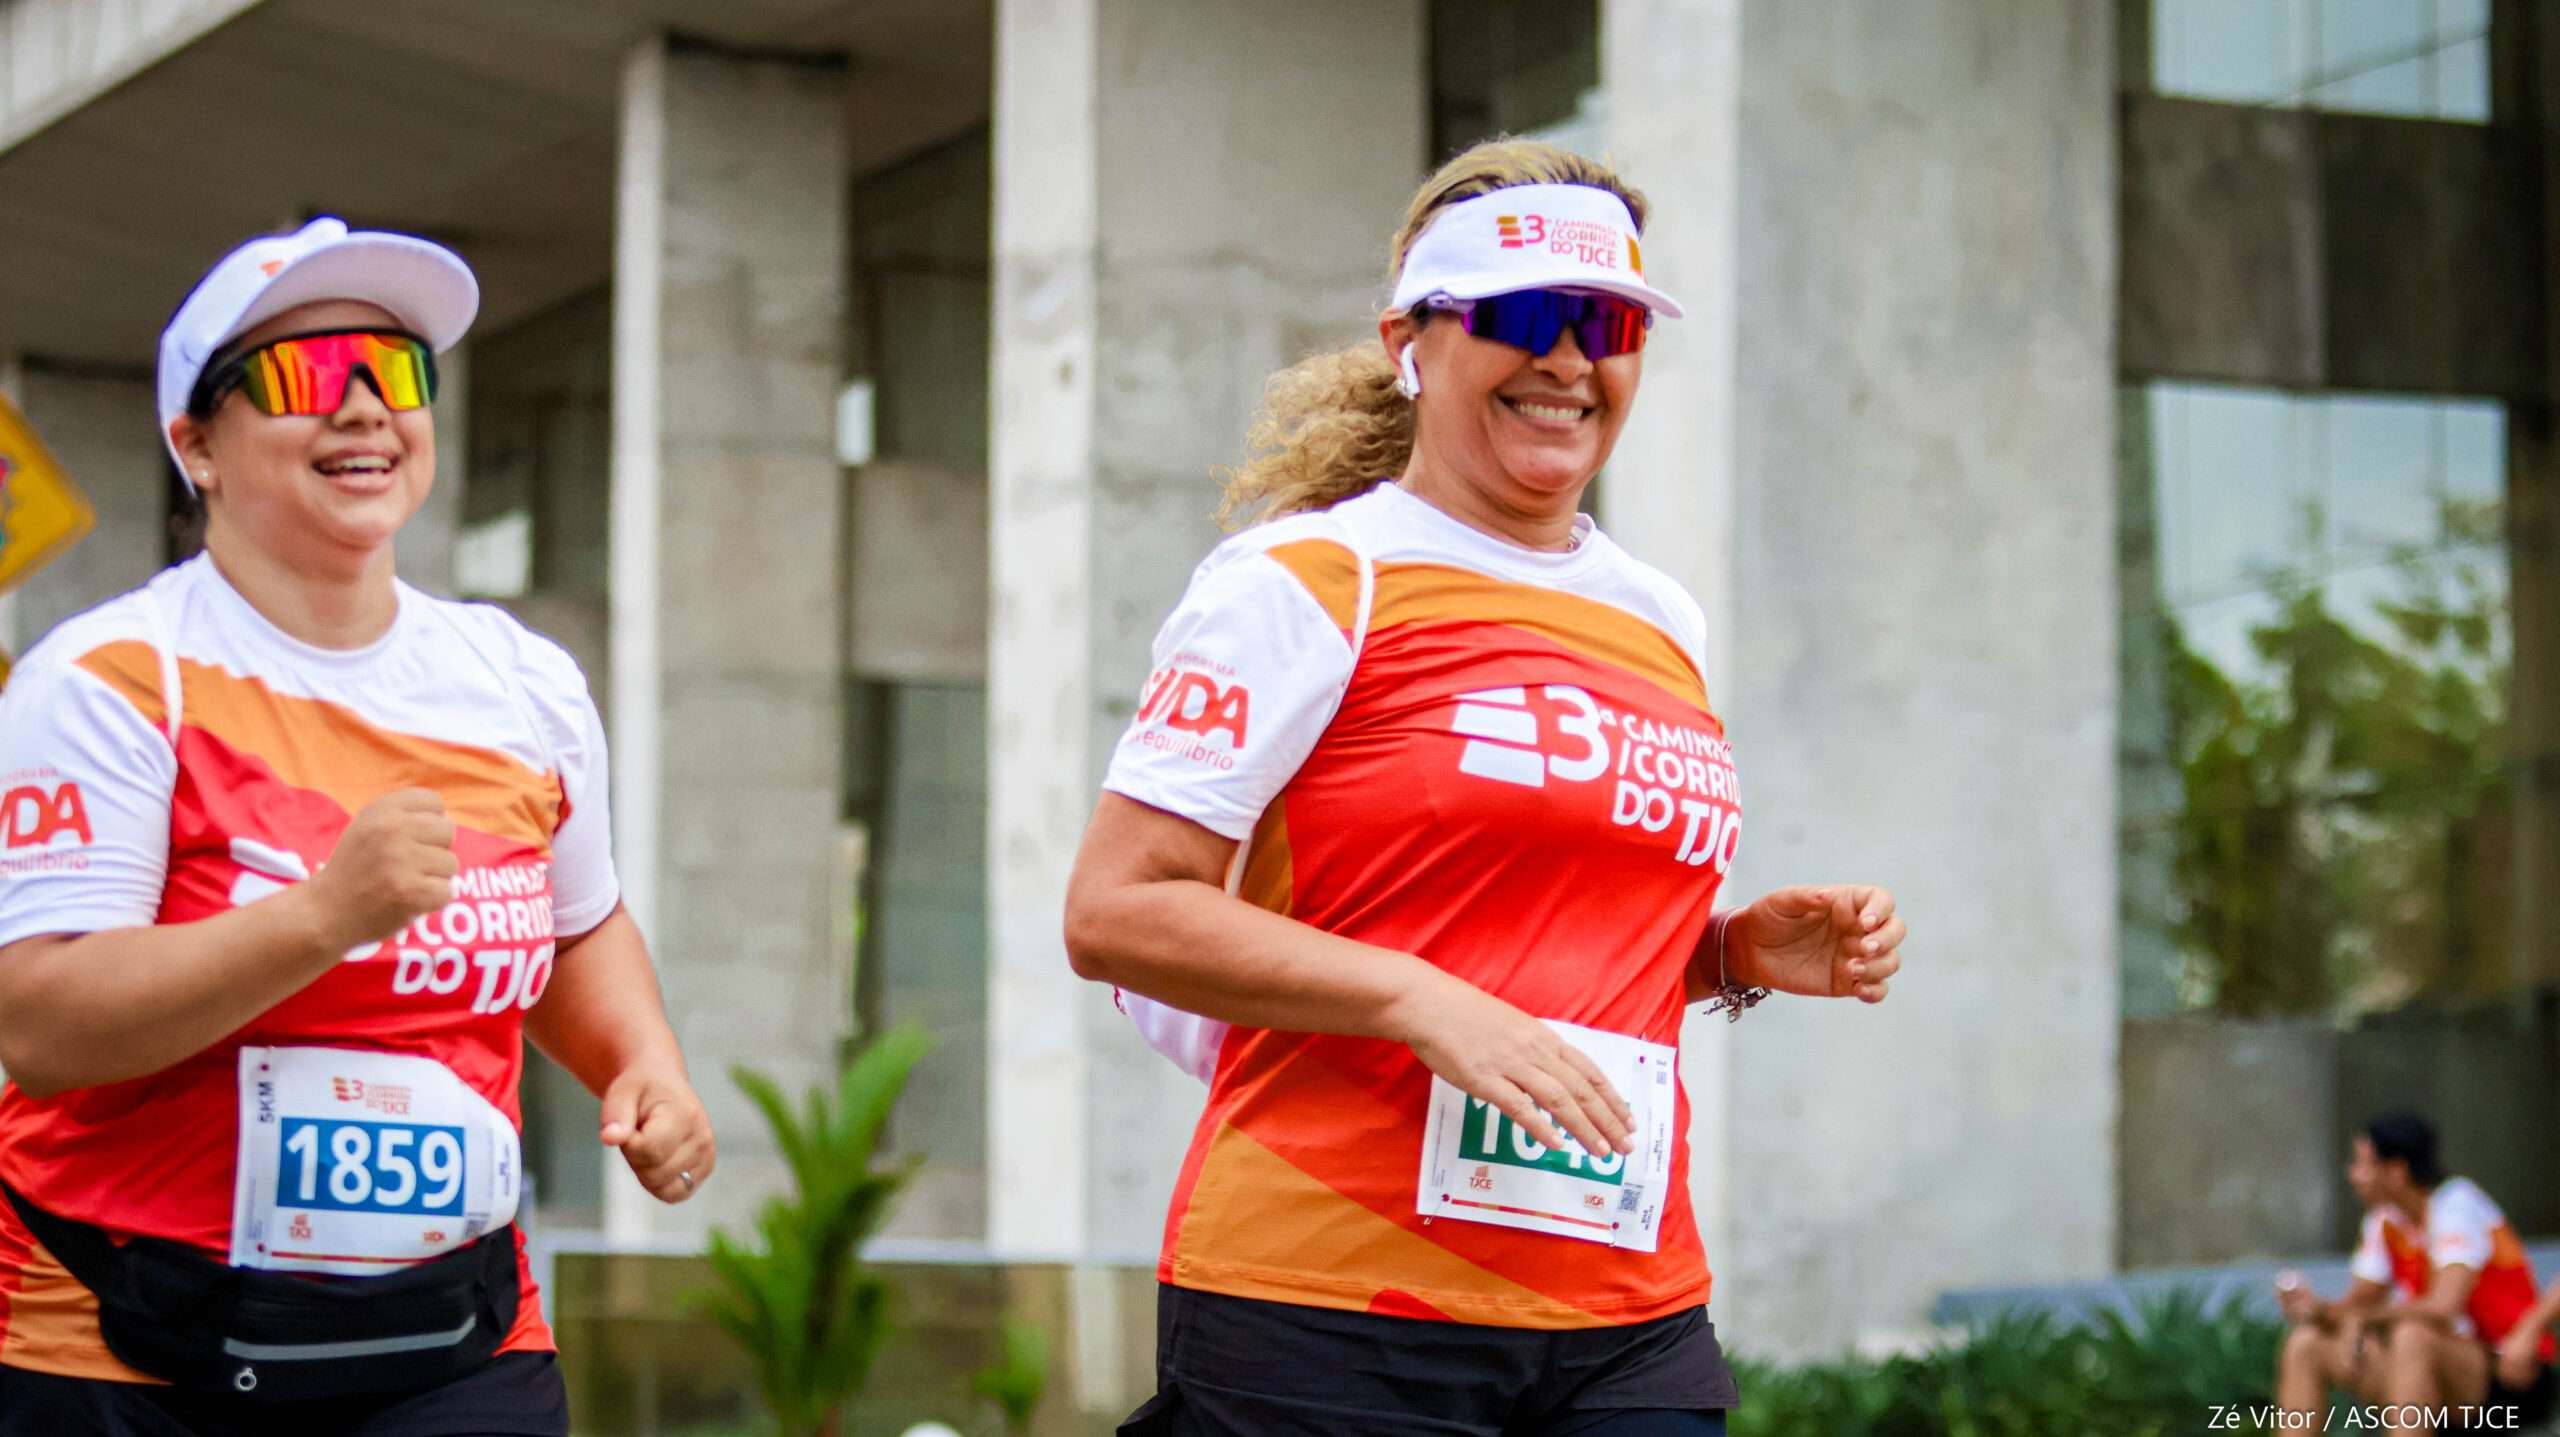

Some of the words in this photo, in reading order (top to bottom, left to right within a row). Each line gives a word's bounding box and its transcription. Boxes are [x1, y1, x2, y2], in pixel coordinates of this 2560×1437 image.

[1551, 240, 1574, 254] DO
[1576, 243, 1617, 269] TJCE
[1555, 218, 1618, 237] CAMINHADA
[1617, 738, 1742, 808] /CORRID
[1612, 779, 1675, 833] DO
[1675, 798, 1742, 876] TJC
[391, 946, 468, 995] DO
[470, 941, 556, 1015] TJC
[257, 1081, 275, 1124] 5KM
[286, 1124, 463, 1209] 1859
[1469, 1176, 1493, 1190] TJCE
